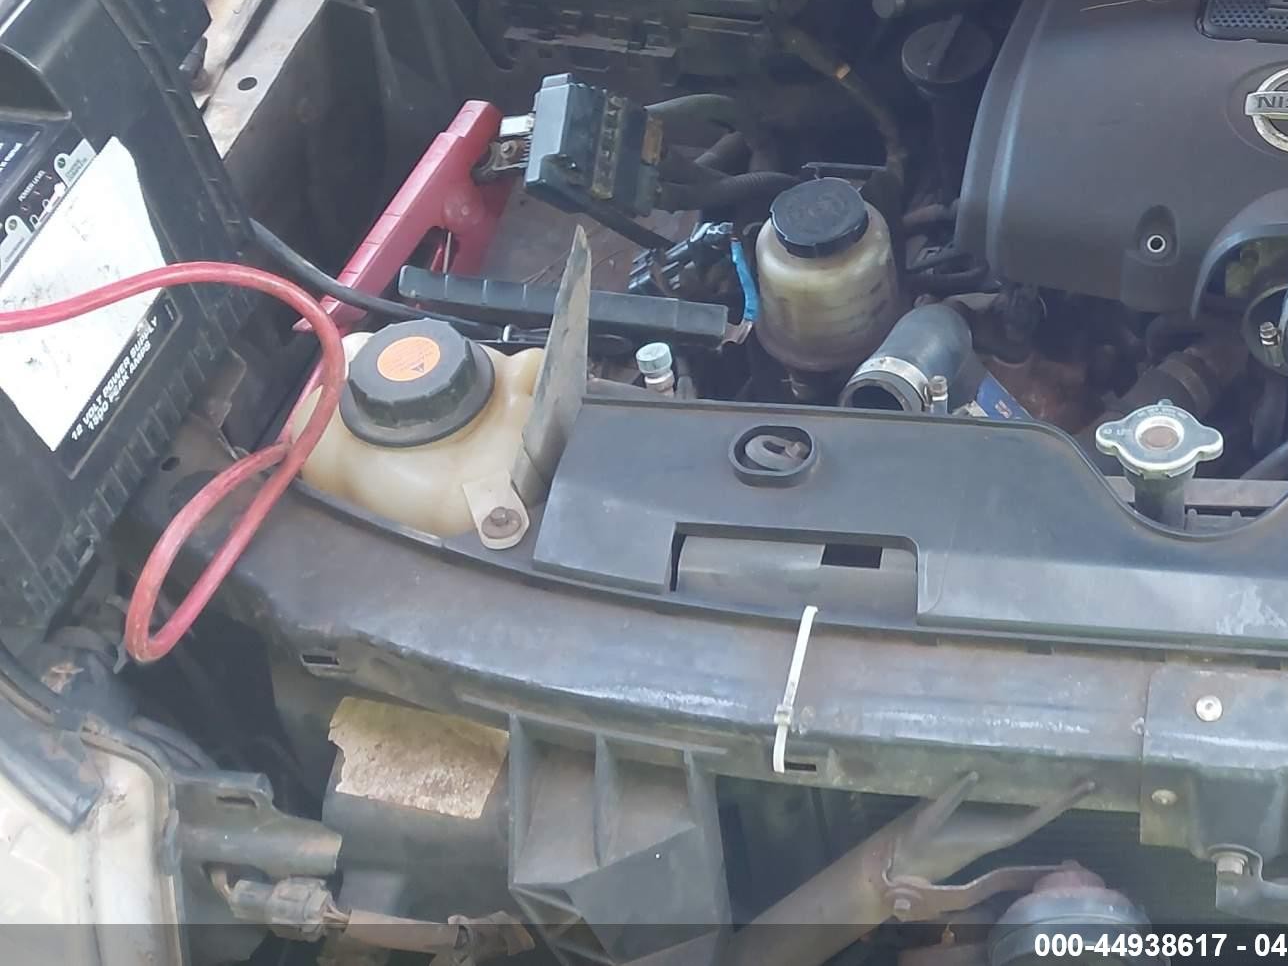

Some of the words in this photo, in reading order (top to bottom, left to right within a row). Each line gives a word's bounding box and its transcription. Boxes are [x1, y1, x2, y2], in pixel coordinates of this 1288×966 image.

[71, 423, 84, 441] 12
[82, 393, 103, 426] VOLT
[102, 355, 131, 399] POWER
[129, 315, 158, 359] SUPPLY
[88, 400, 110, 431] 1500
[108, 371, 130, 404] PEAK
[129, 340, 151, 375] AMPS
